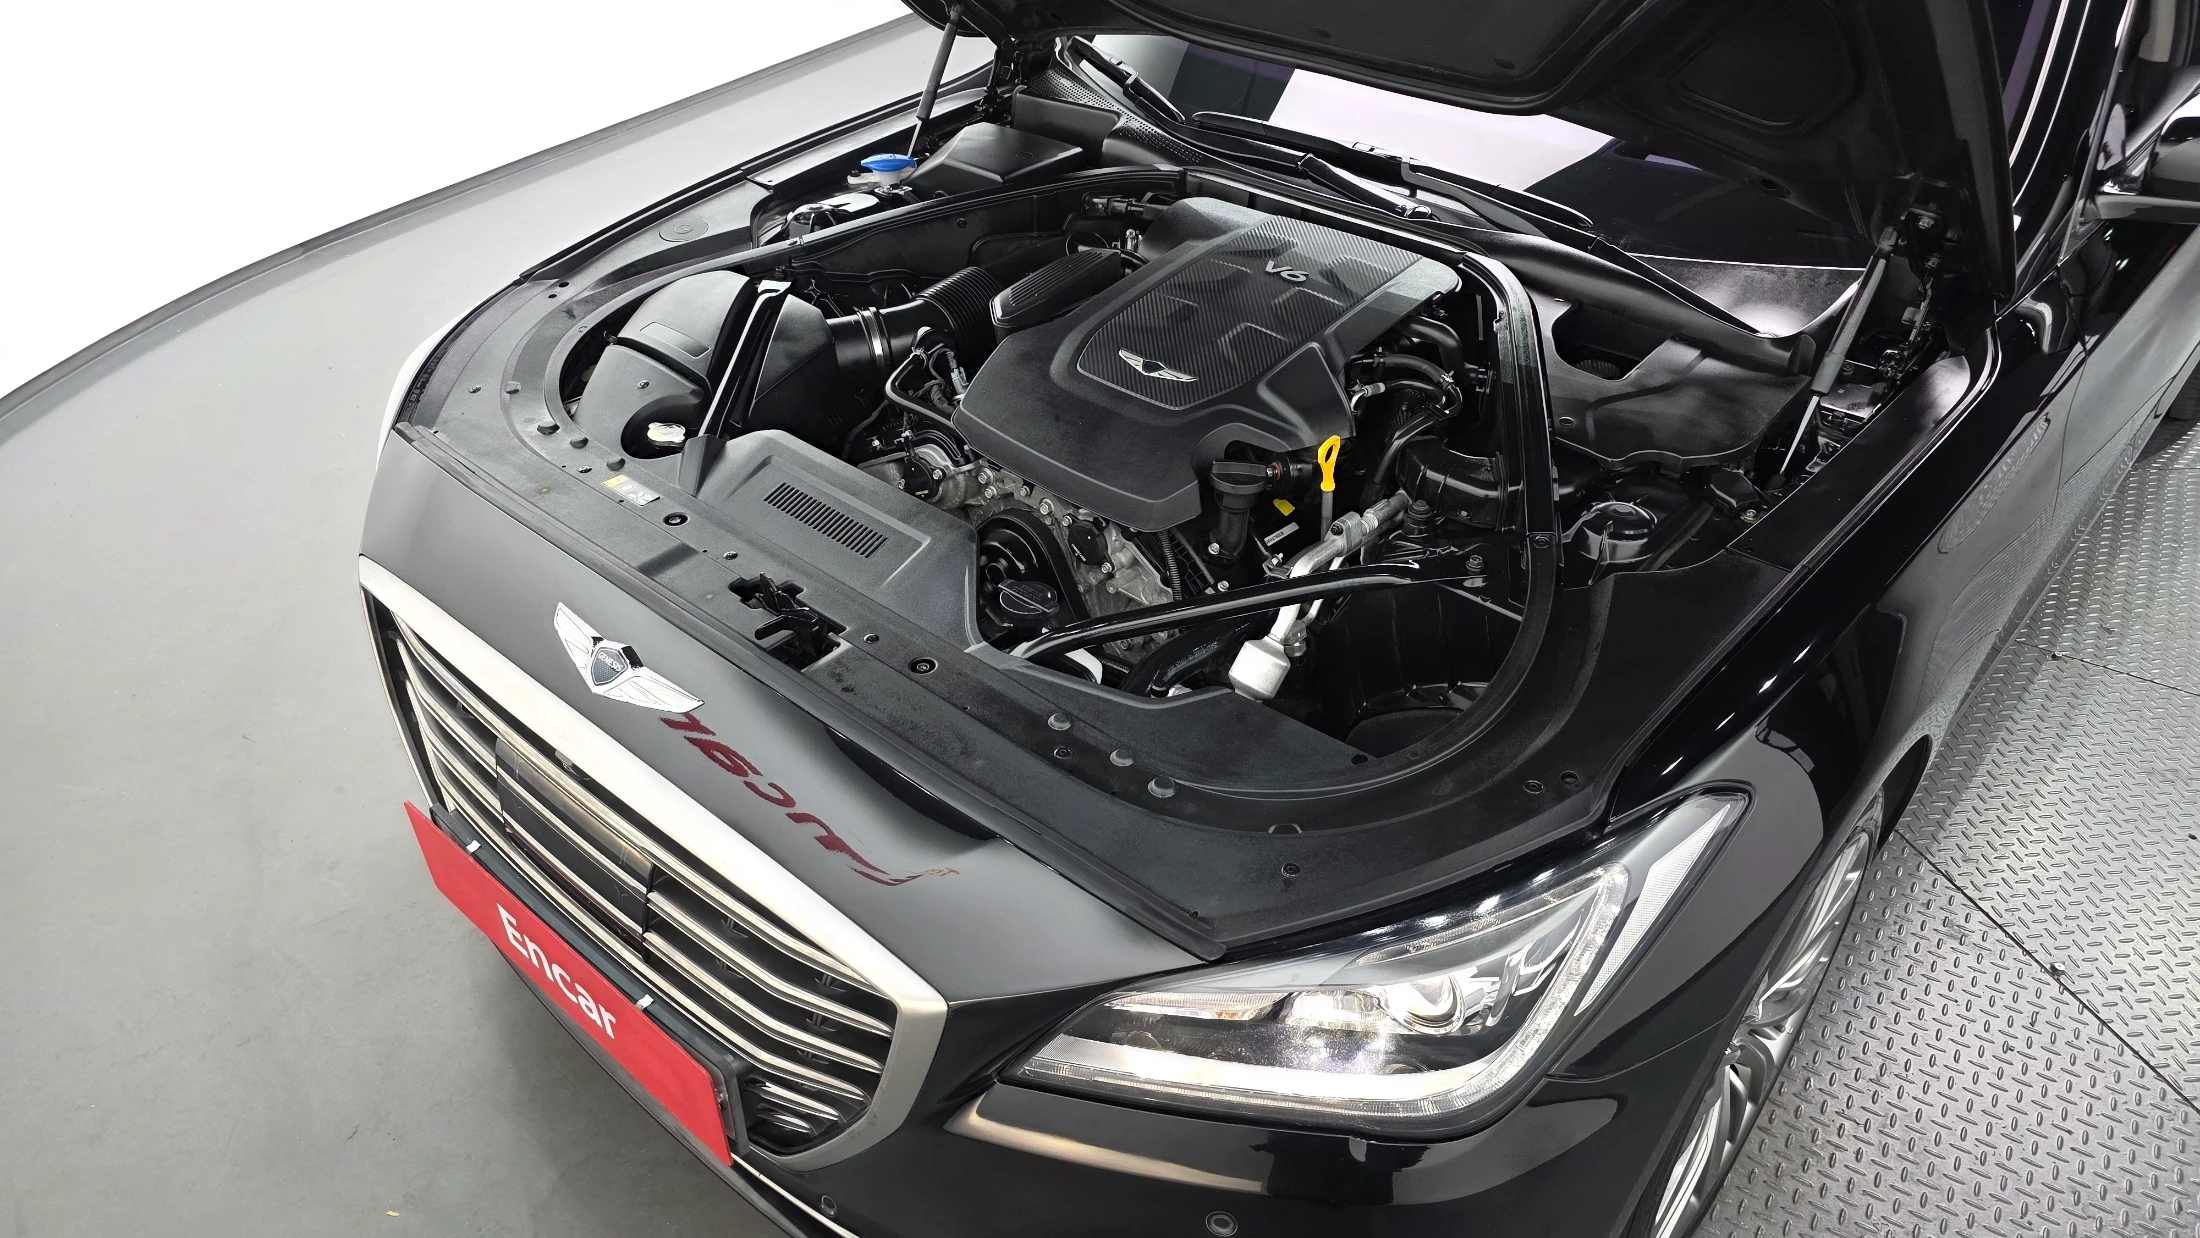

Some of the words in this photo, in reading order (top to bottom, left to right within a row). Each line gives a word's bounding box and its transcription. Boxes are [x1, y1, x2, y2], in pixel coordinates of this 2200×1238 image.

[1265, 260, 1310, 282] V6
[597, 651, 623, 672] GENESIS
[496, 902, 617, 1040] Encar
